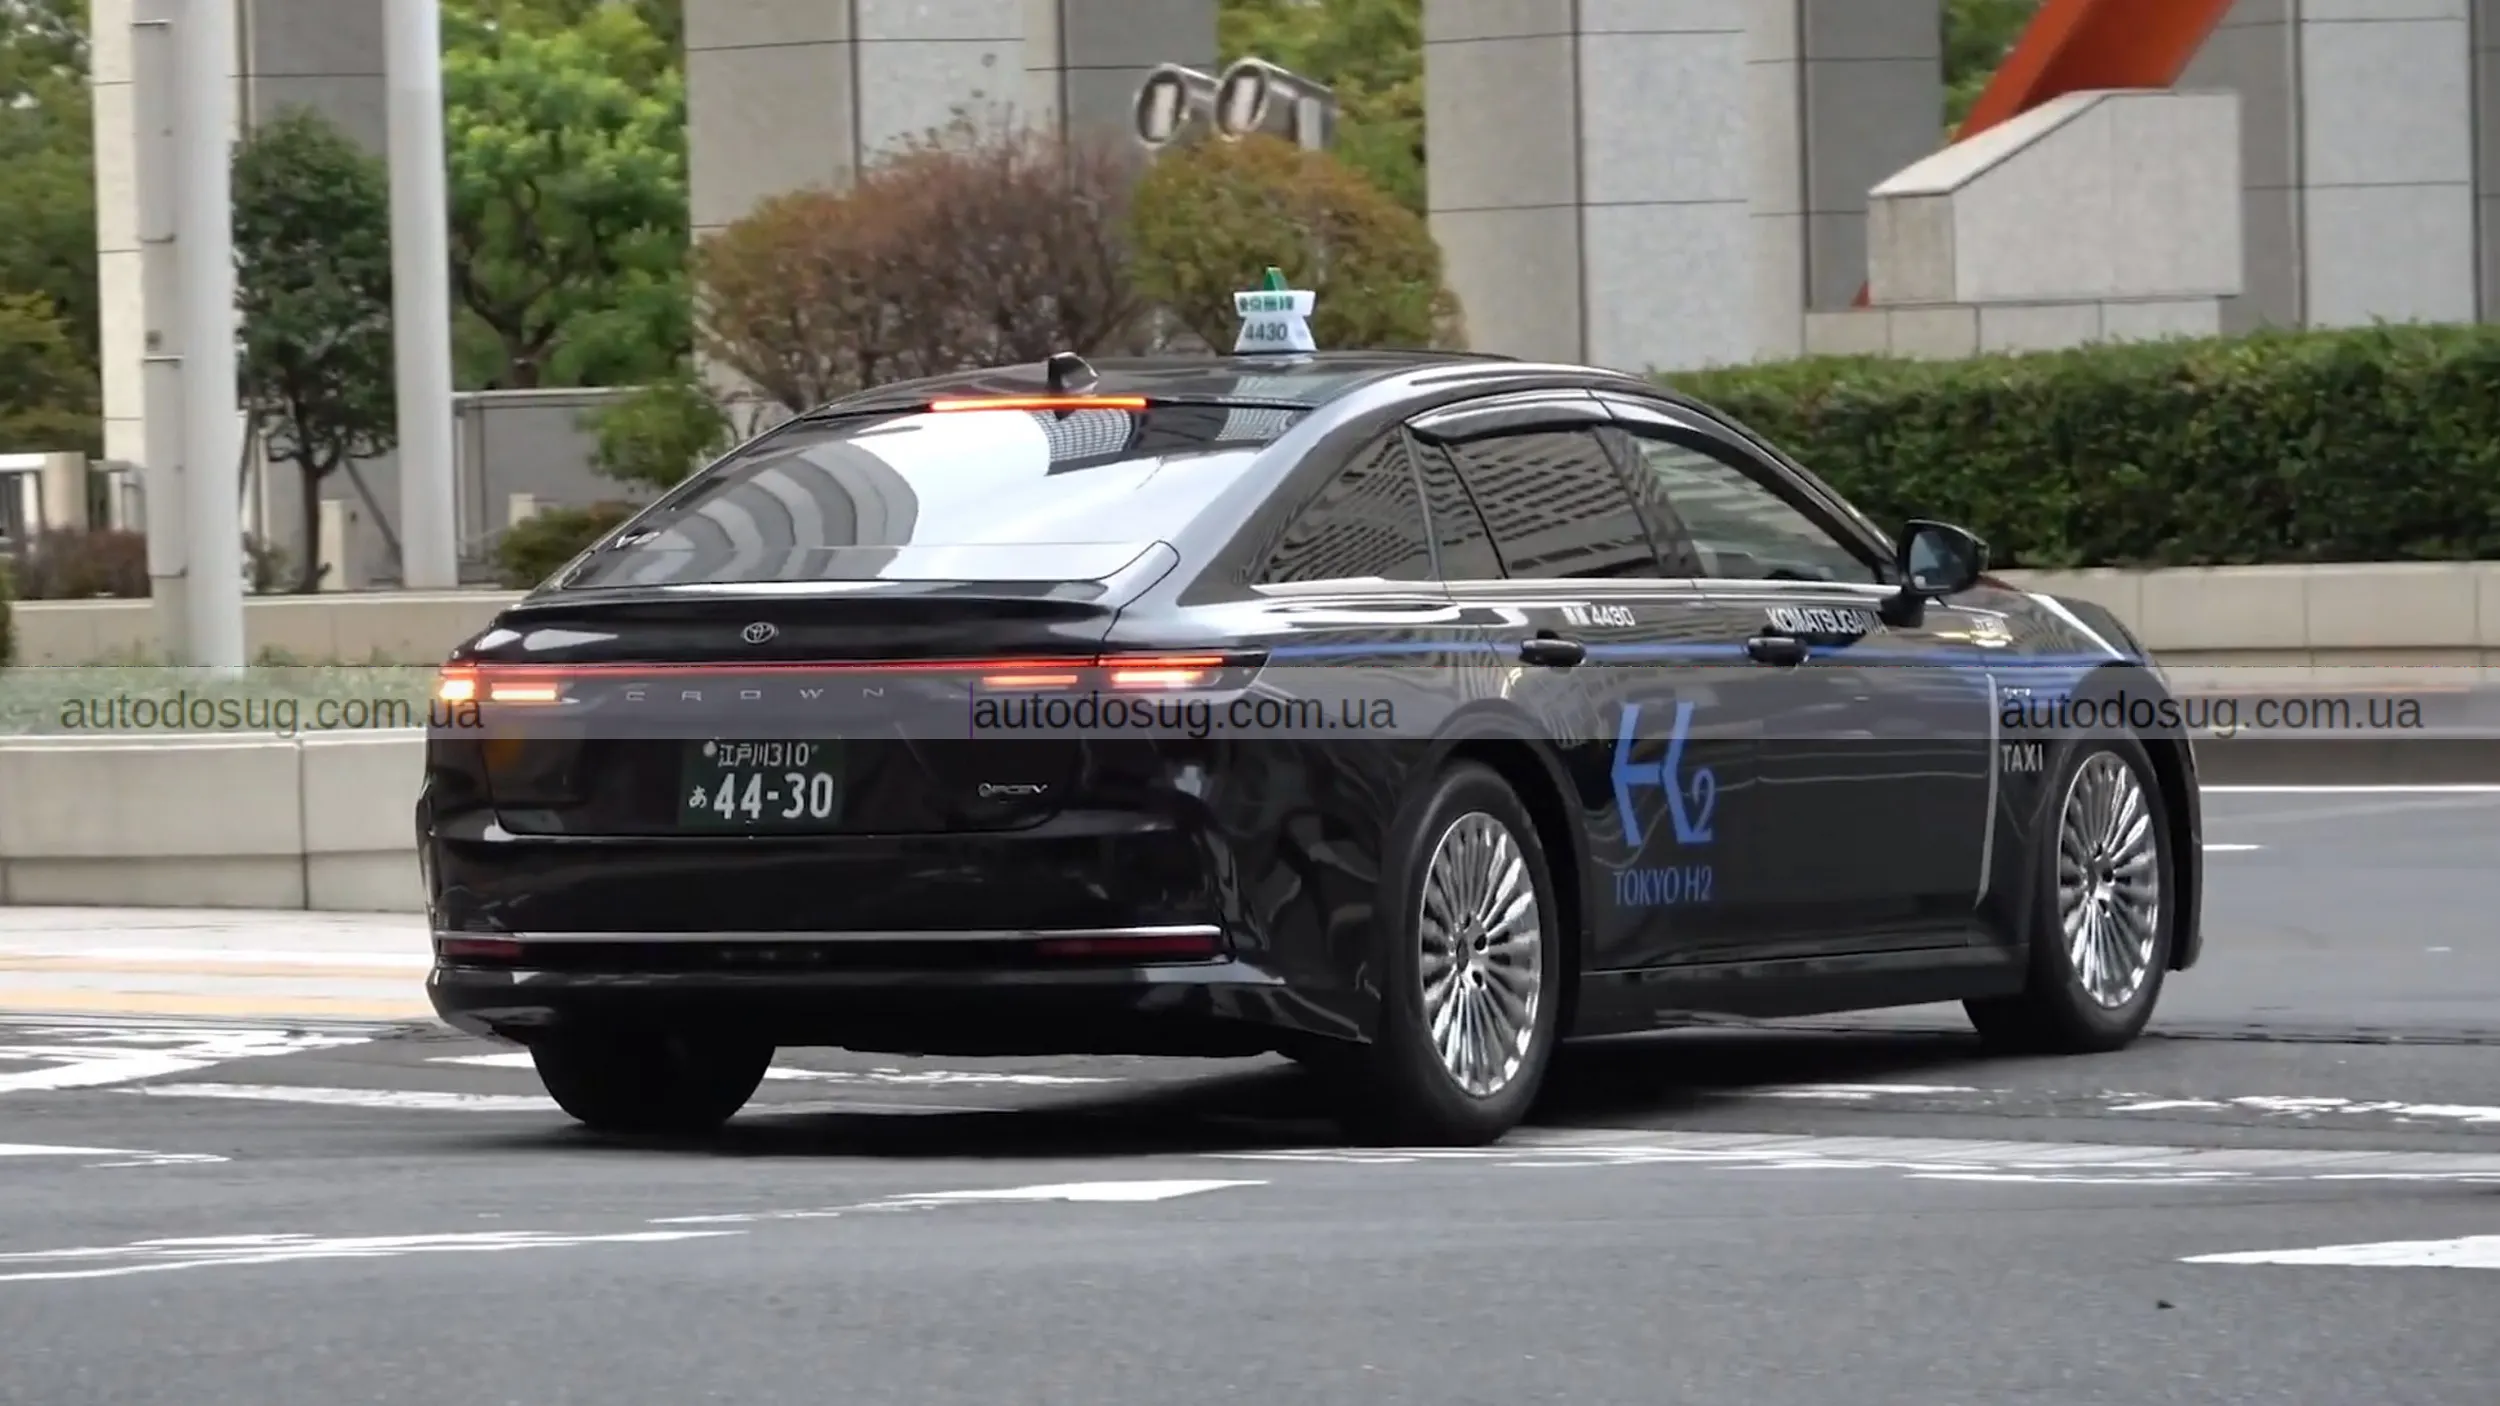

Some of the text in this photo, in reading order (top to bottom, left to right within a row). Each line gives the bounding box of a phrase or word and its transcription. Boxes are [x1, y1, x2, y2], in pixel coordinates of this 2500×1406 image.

[1244, 322, 1288, 341] 4430
[626, 687, 884, 701] CROWN
[2001, 743, 2043, 772] TAXI
[688, 772, 833, 819] あ 44-30
[1613, 865, 1712, 905] TOKYO H2
